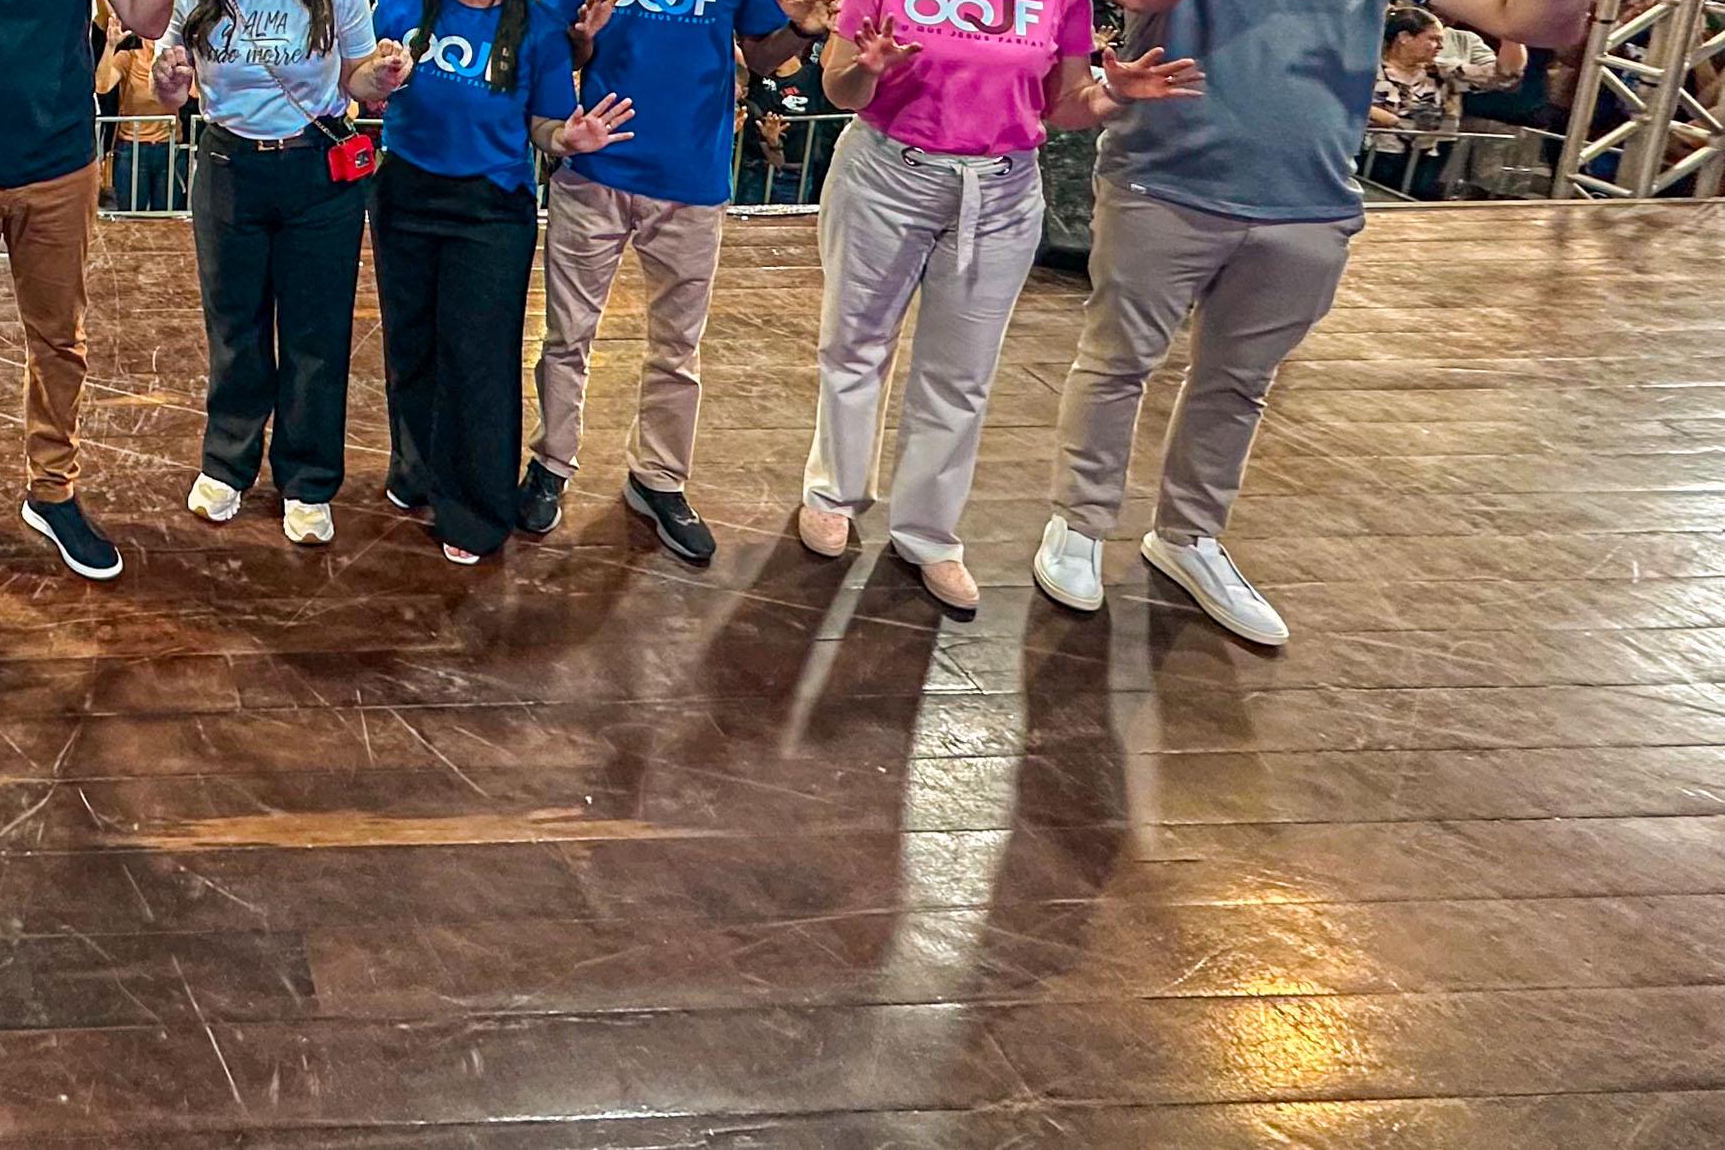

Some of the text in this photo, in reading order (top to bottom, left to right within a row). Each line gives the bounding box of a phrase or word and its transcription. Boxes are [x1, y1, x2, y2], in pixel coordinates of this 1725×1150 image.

[242, 10, 289, 38] ALMA
[916, 26, 942, 35] QUE
[950, 30, 990, 42] JESUS
